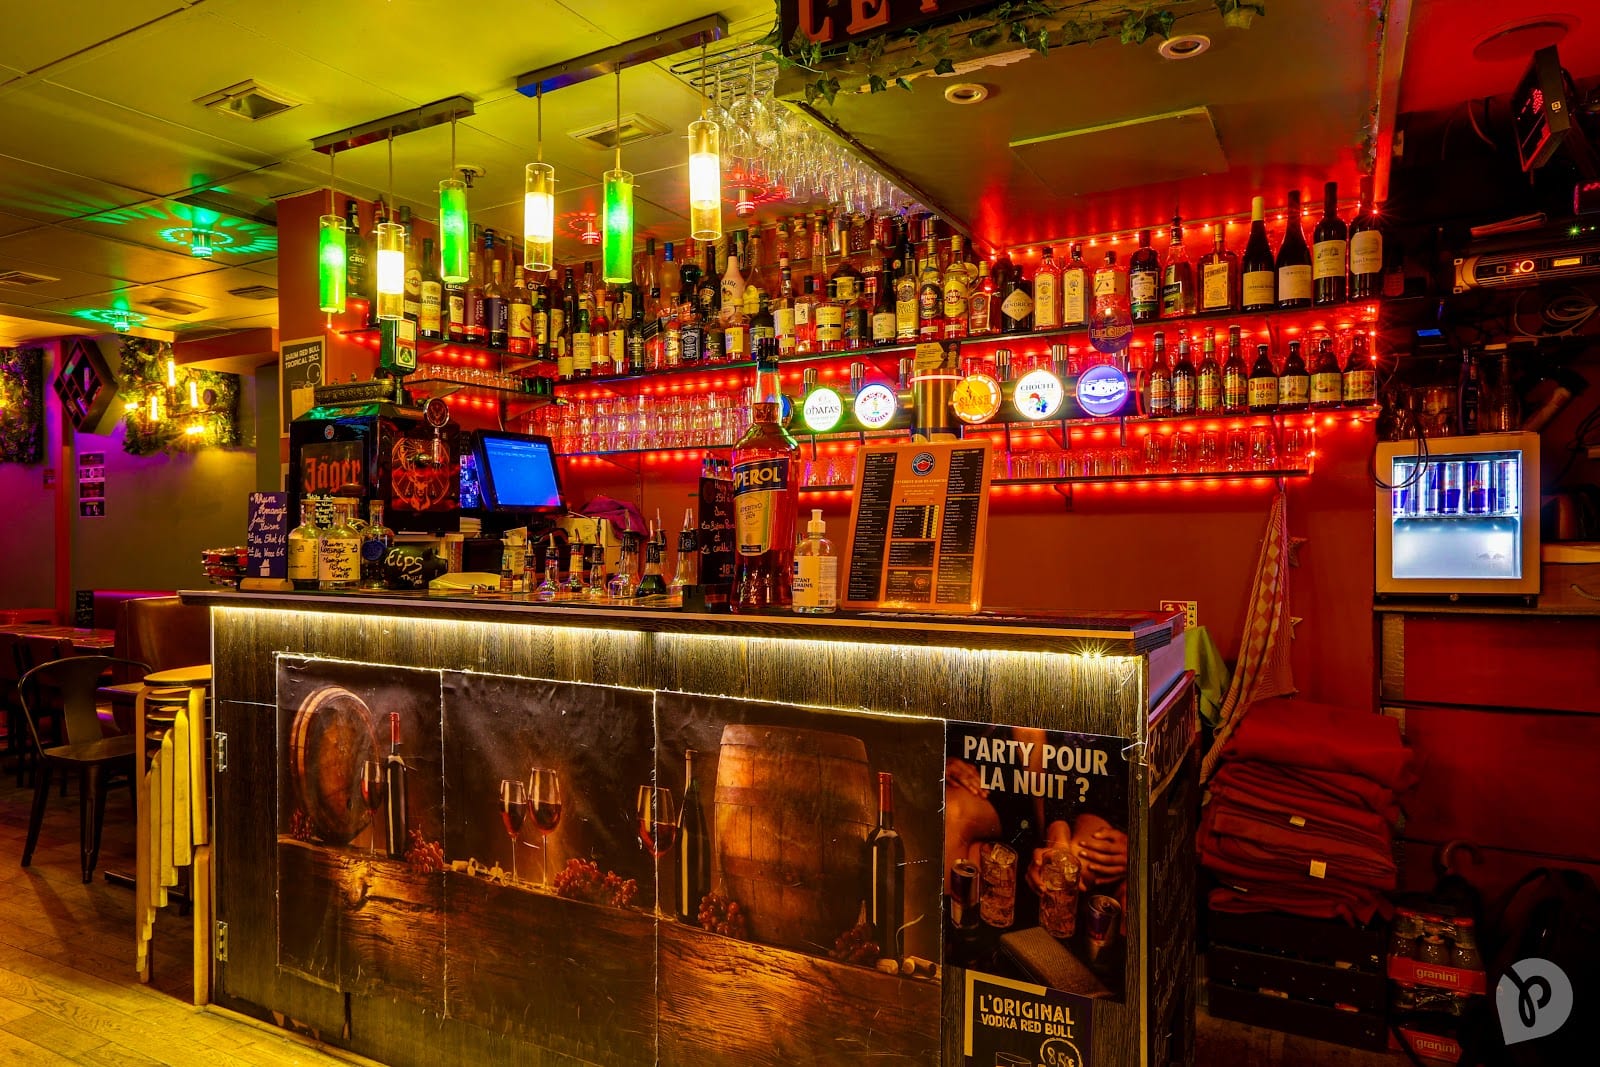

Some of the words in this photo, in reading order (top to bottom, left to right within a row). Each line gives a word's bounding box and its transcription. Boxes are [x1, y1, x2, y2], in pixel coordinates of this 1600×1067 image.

[964, 735, 1034, 767] PARTY
[1042, 743, 1109, 776] POUR
[980, 765, 1006, 792] LA
[1013, 769, 1068, 800] NUIT
[1075, 776, 1090, 803] ?
[1416, 968, 1457, 983] granini
[980, 994, 1075, 1025] L'ORIGINAL
[981, 1012, 1018, 1030] VODKA
[1020, 1019, 1042, 1034] RED
[1044, 1022, 1074, 1039] BULL
[1416, 1039, 1456, 1054] granini
